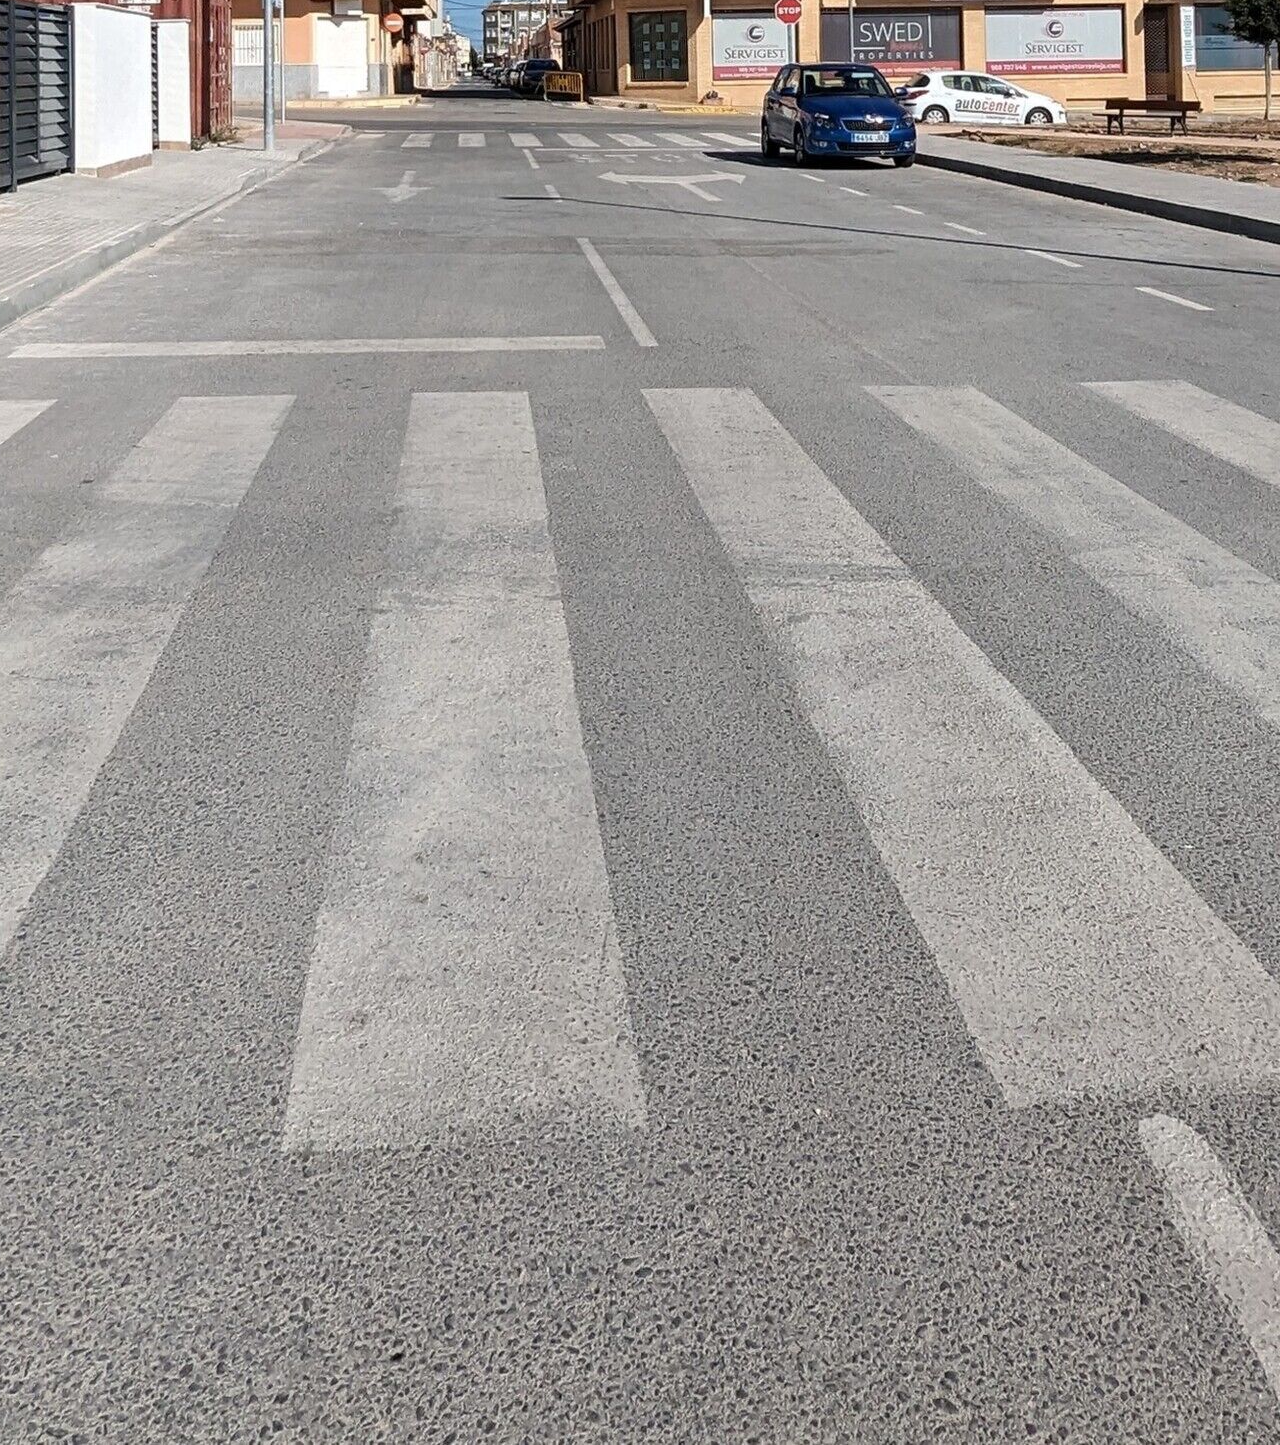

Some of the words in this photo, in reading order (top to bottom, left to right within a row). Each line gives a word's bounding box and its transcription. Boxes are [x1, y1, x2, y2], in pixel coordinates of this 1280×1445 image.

[778, 7, 801, 15] STOP
[859, 22, 923, 43] SWED
[724, 47, 786, 60] SERVIGEST
[1025, 42, 1085, 55] SERVIGEST
[954, 98, 1021, 113] autocenter
